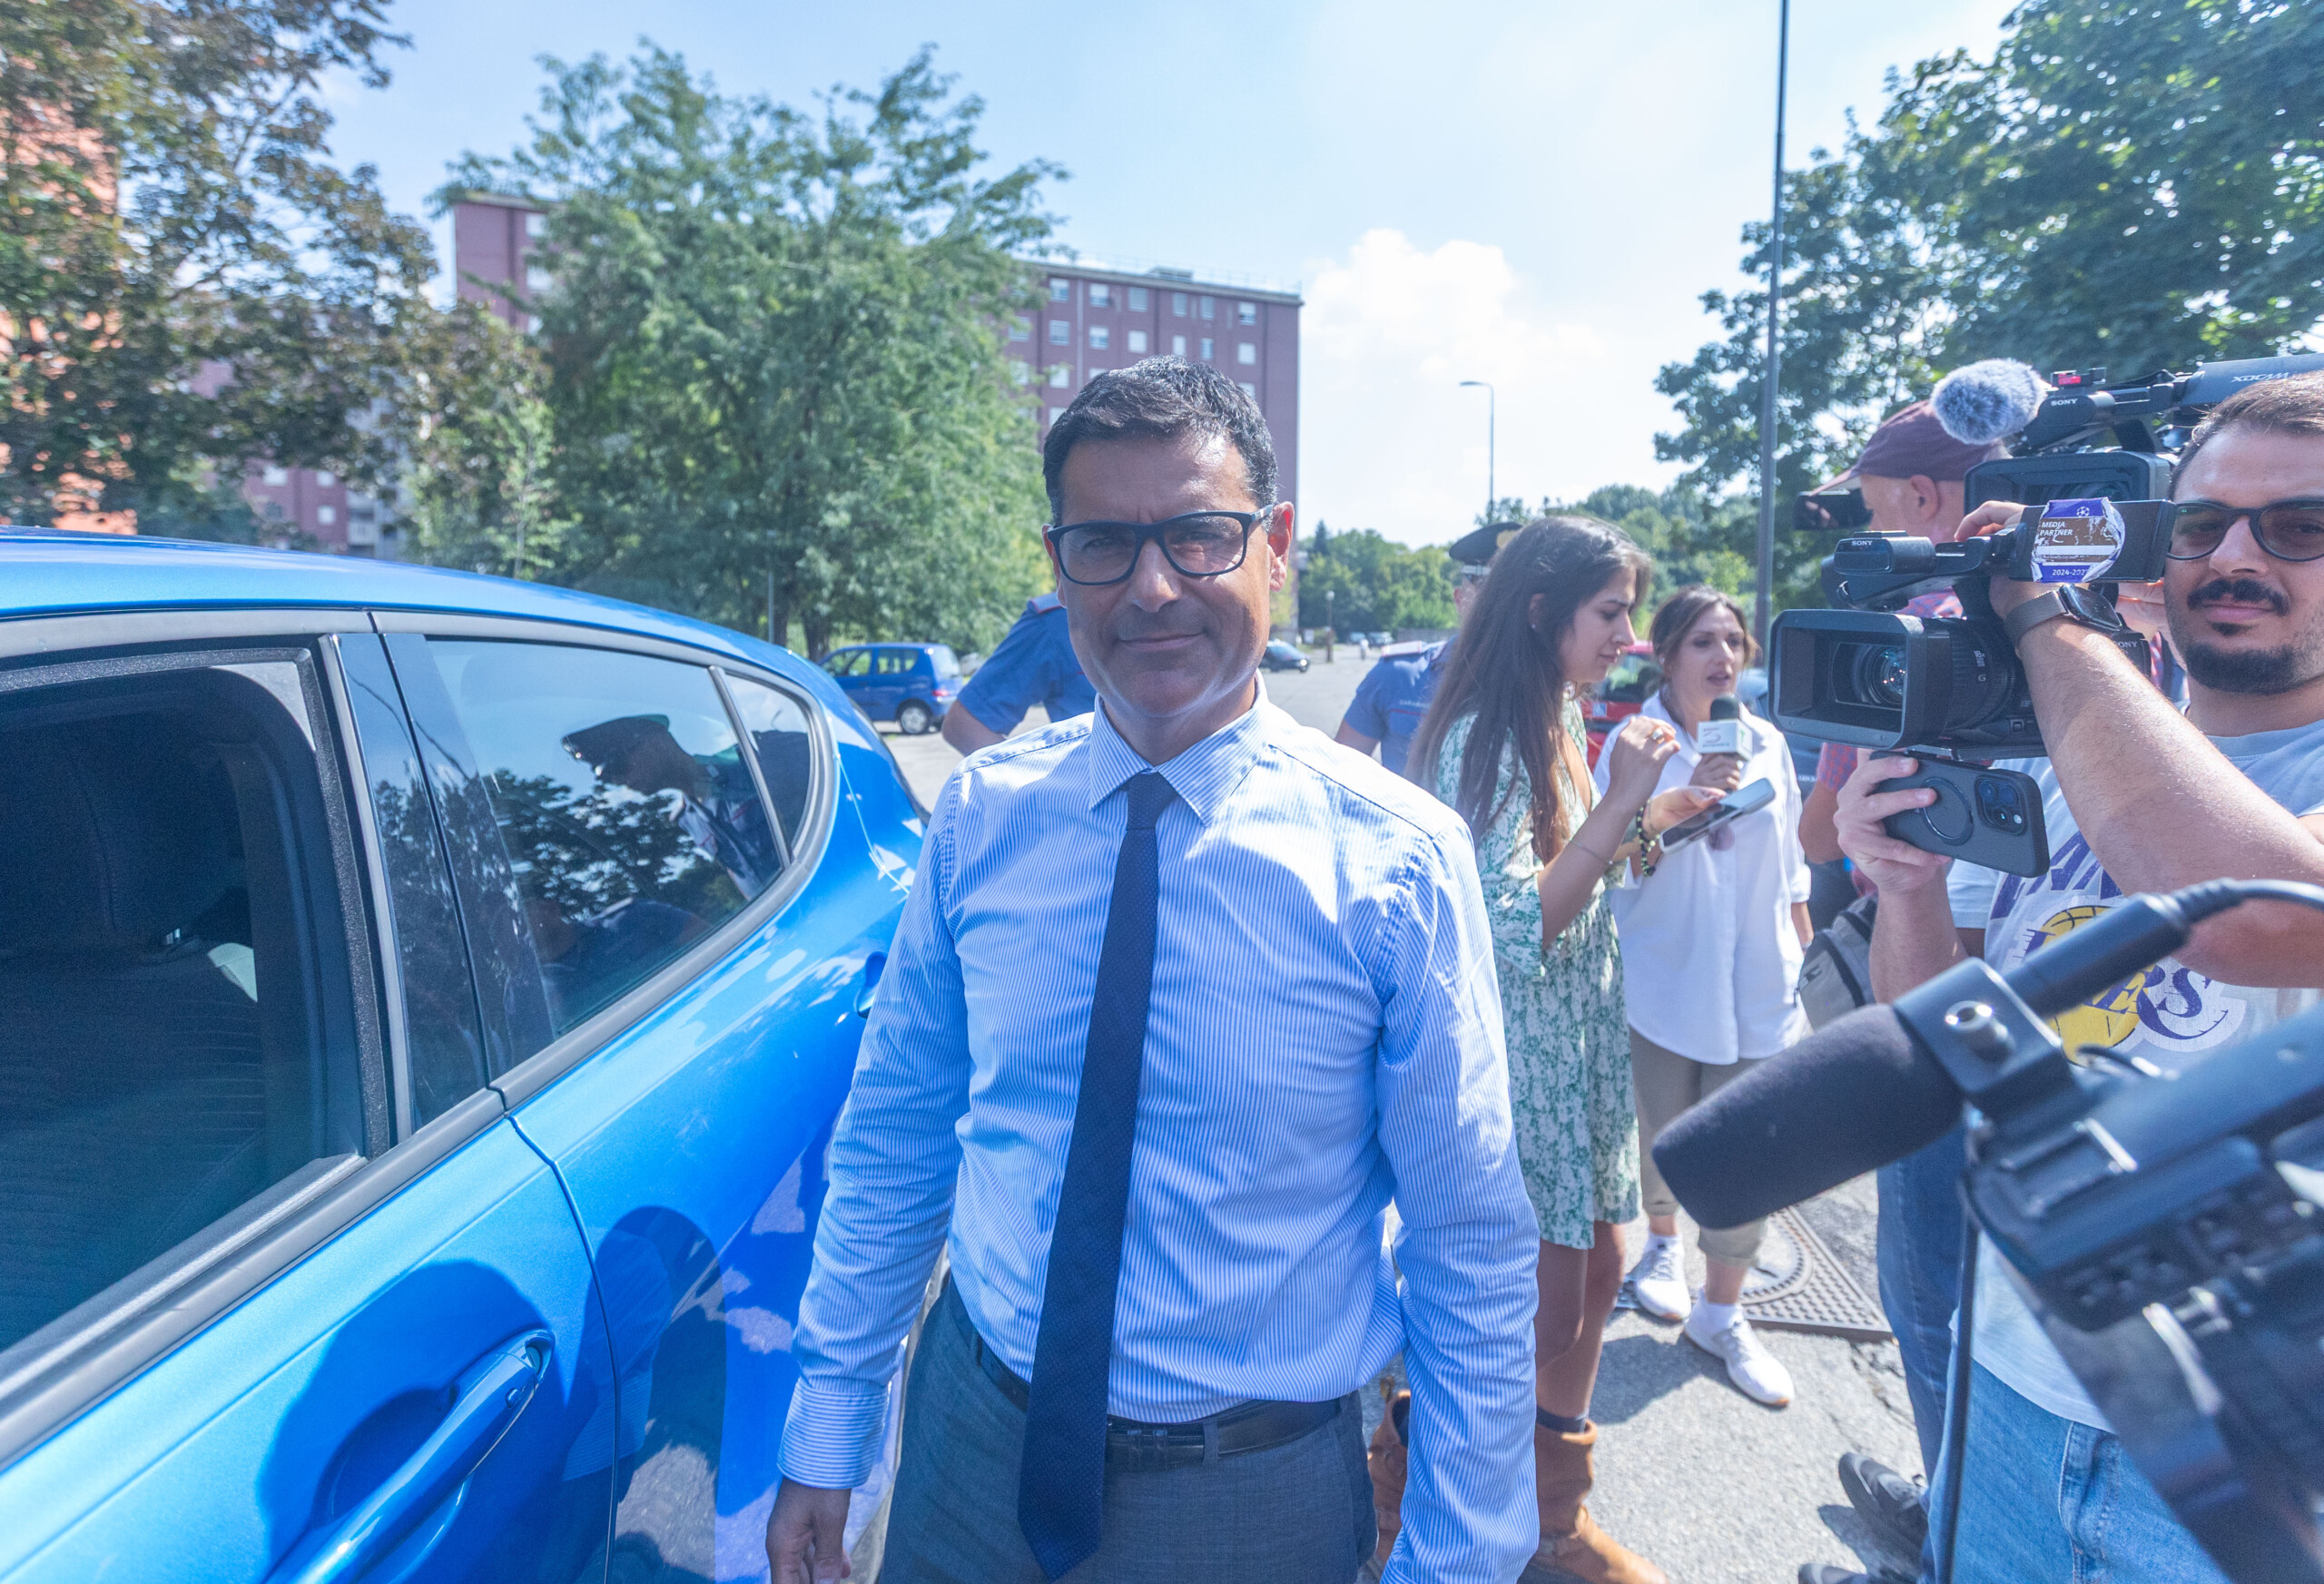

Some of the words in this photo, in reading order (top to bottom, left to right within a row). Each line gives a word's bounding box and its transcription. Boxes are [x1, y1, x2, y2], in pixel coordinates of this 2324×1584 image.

[2230, 372, 2290, 382] XDCAM
[2051, 398, 2079, 407] SONY
[2039, 528, 2073, 536] PARTNER
